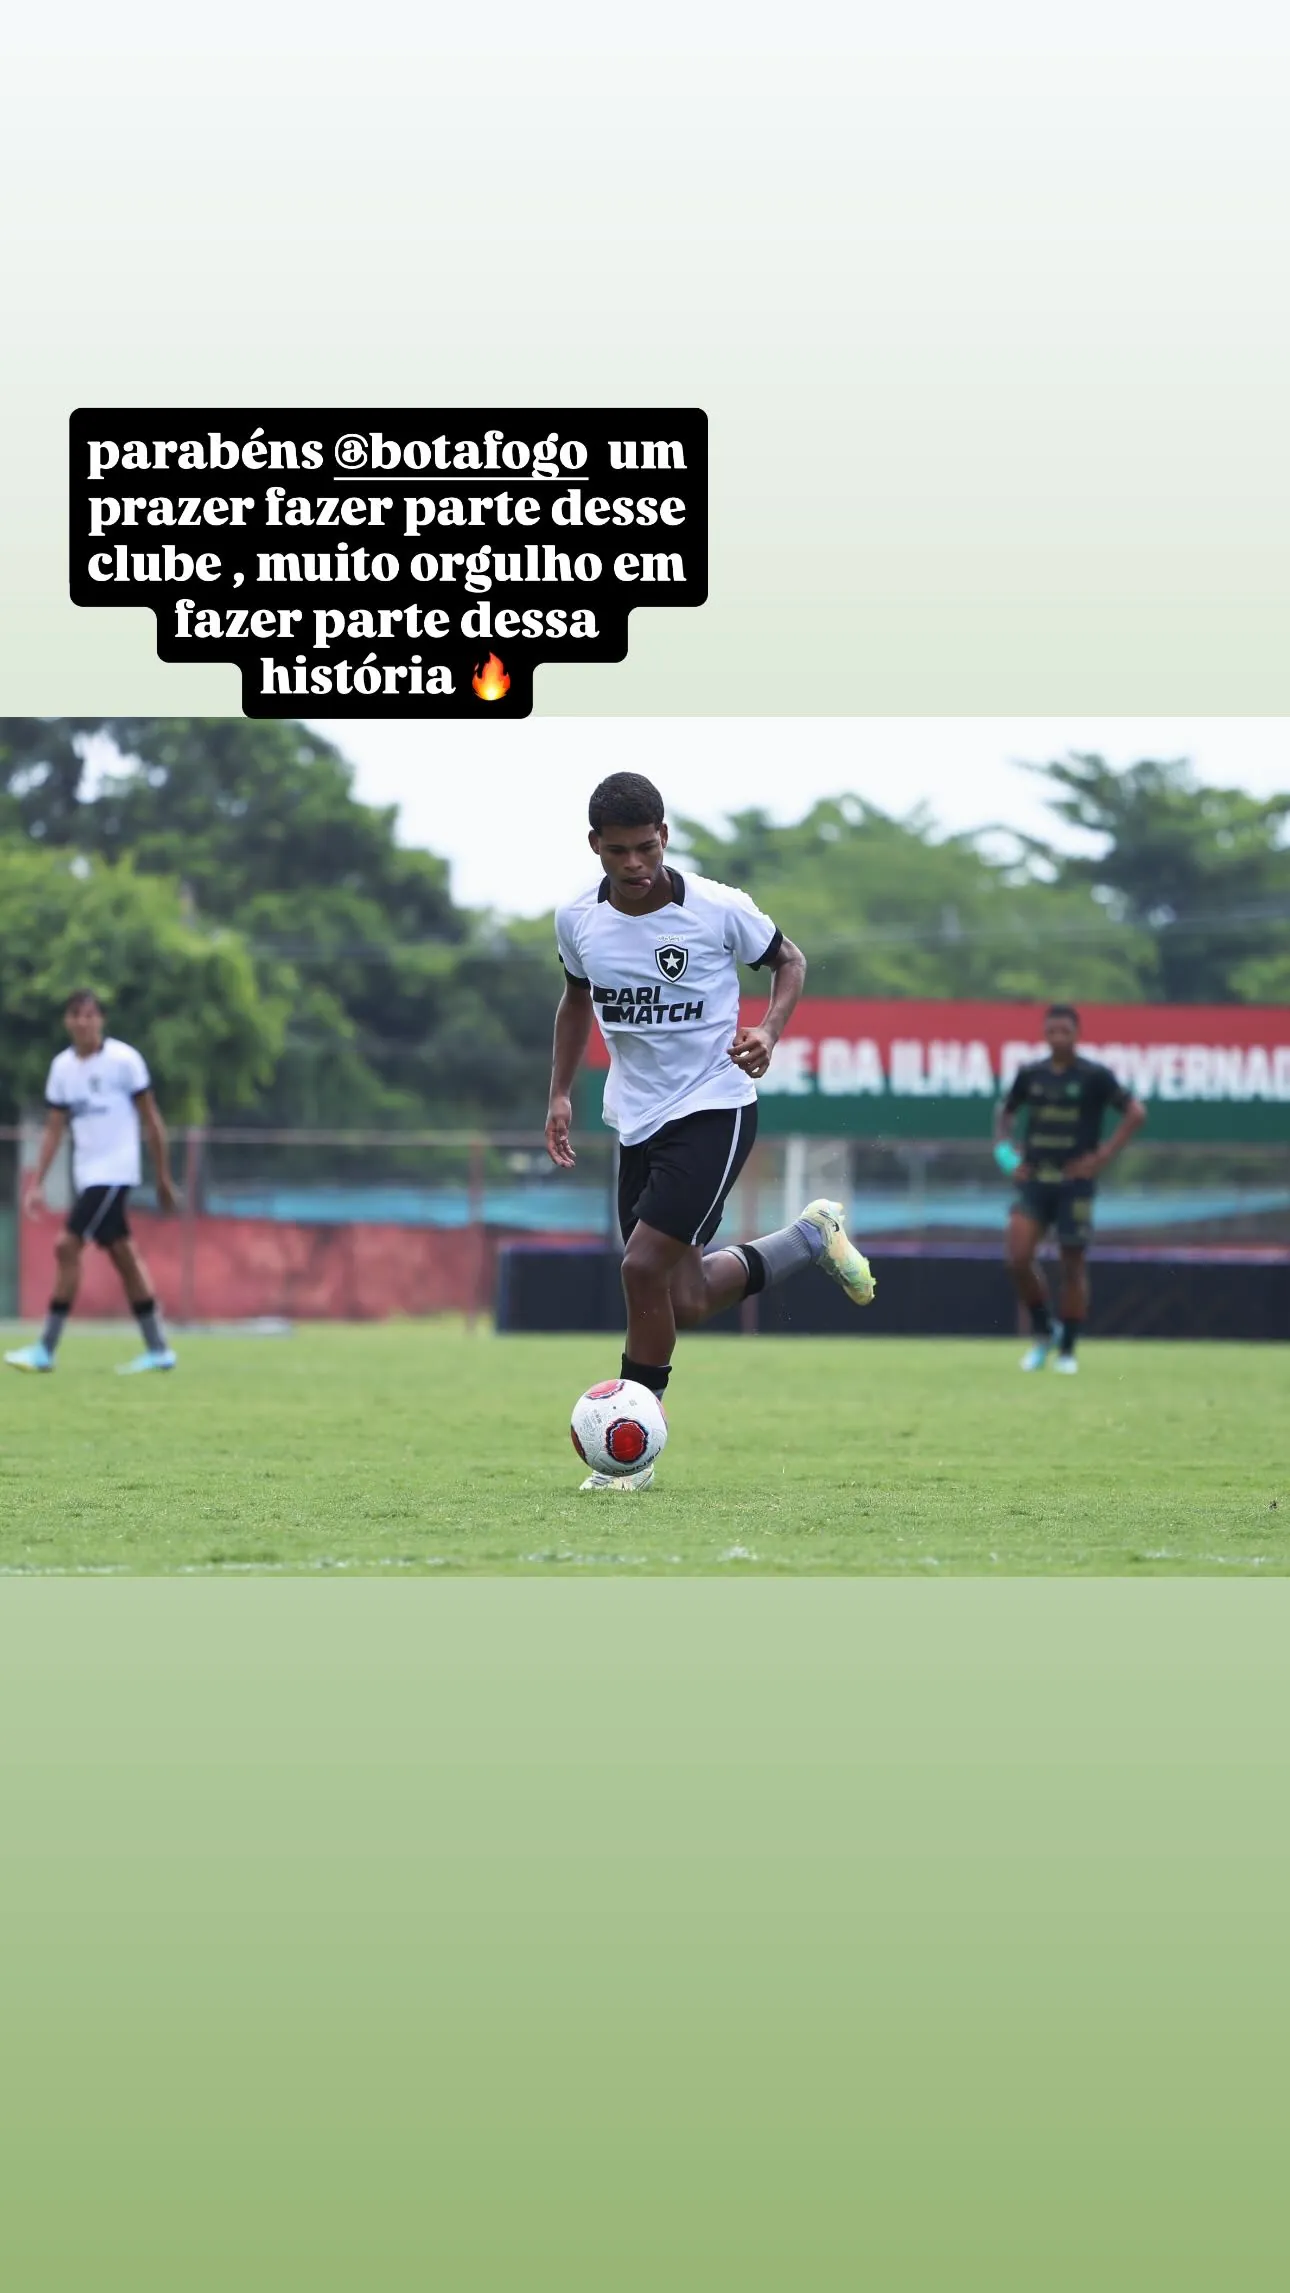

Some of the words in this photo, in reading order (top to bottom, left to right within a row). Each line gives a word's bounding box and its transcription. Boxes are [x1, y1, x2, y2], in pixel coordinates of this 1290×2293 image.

[597, 985, 661, 1004] PARI
[607, 1001, 704, 1024] MATCH
[818, 1037, 886, 1097] DA
[890, 1039, 995, 1099] ILHA
